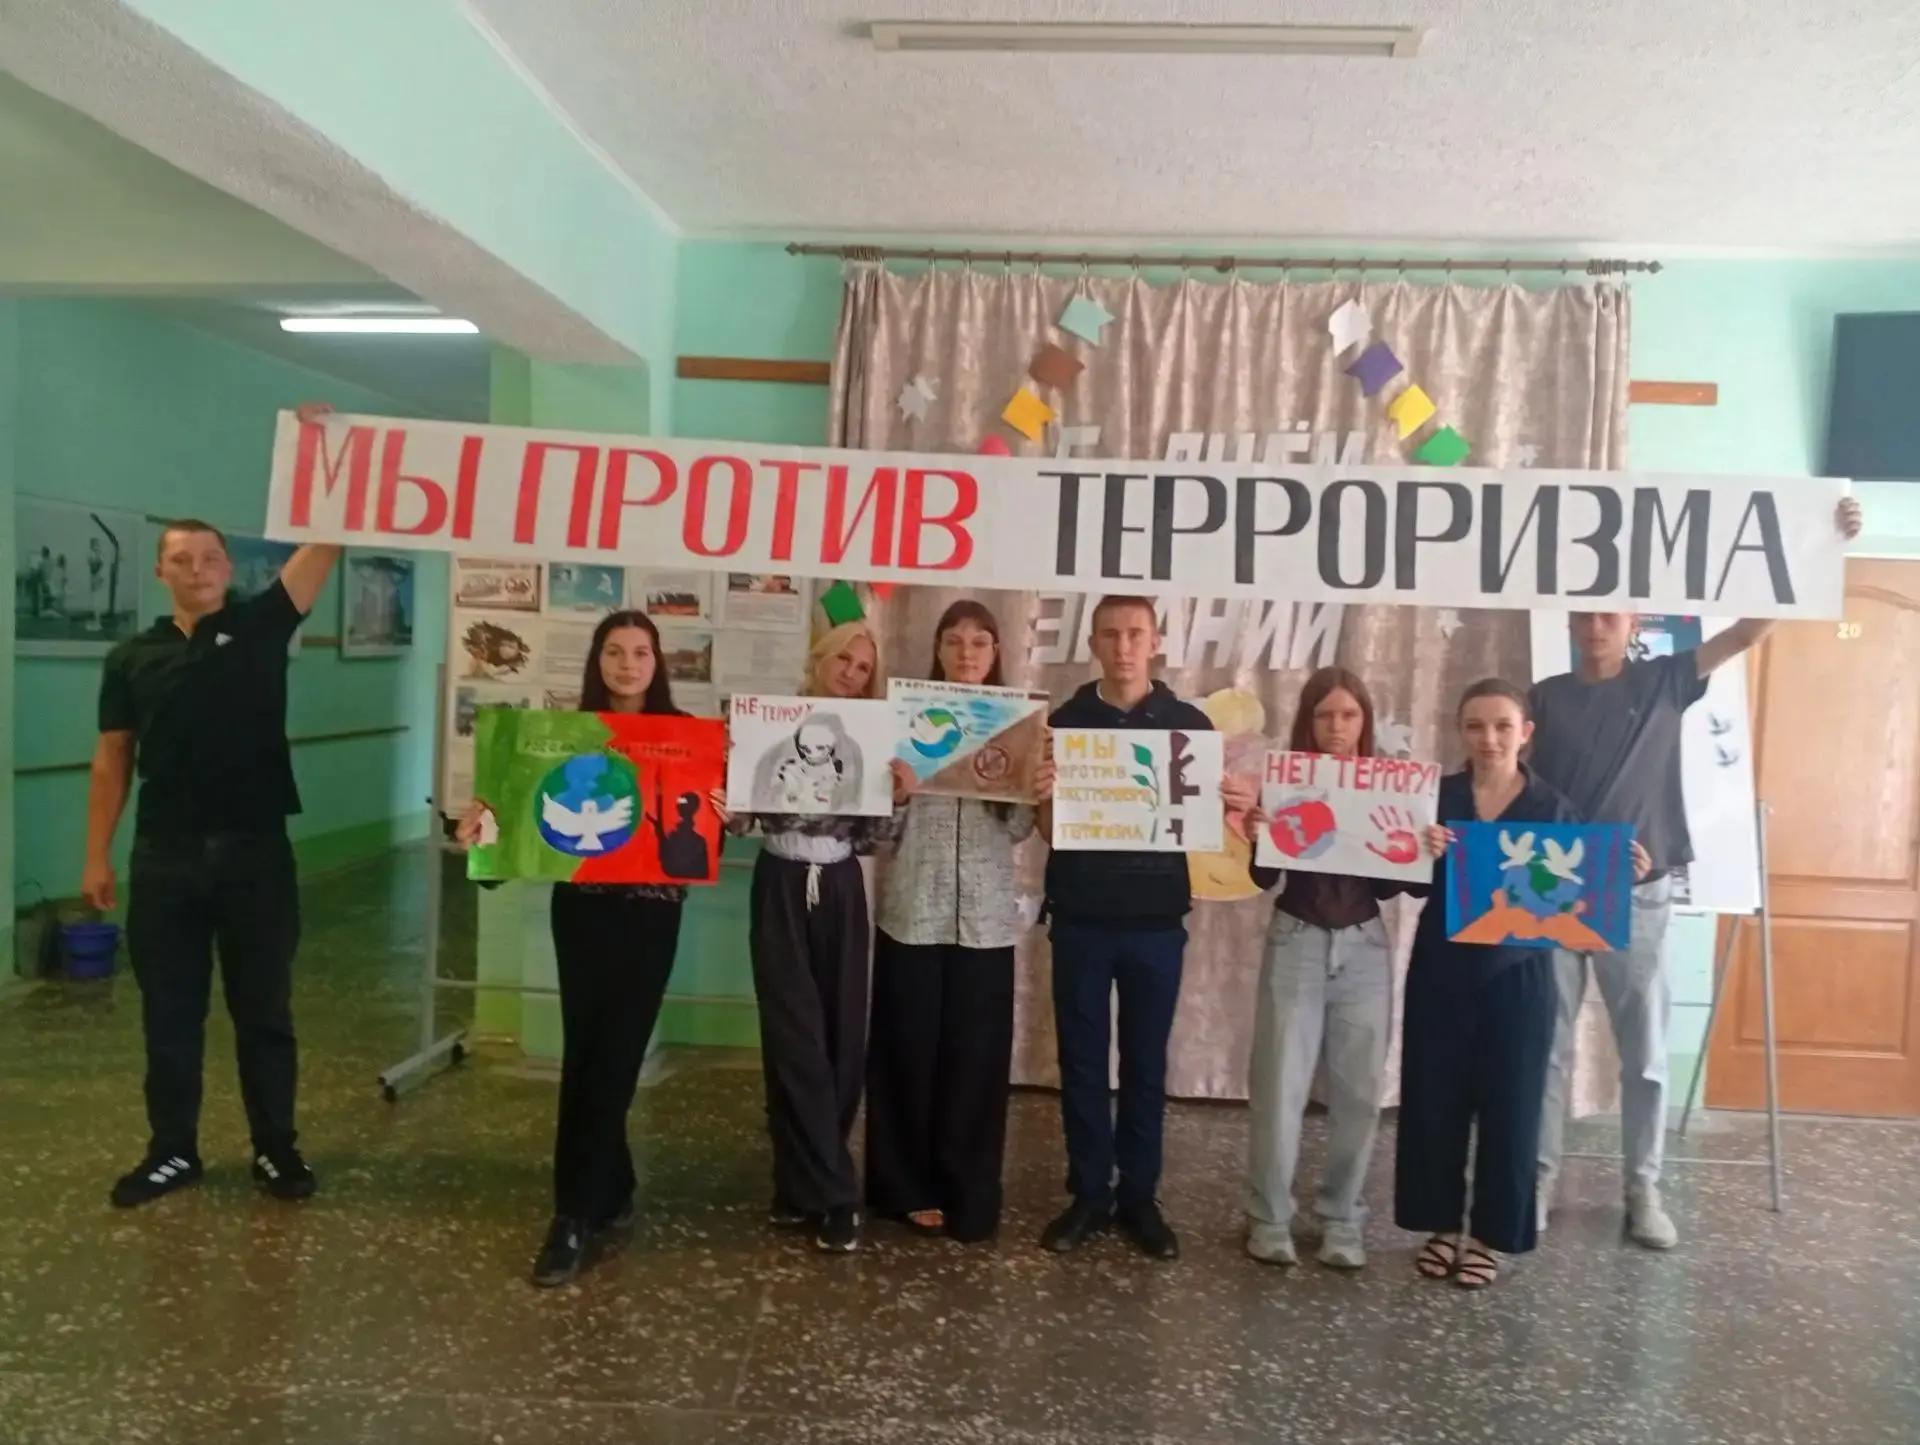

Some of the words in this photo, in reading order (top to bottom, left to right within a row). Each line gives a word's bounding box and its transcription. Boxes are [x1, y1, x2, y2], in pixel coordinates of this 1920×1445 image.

[289, 421, 483, 540] МЫ
[513, 440, 980, 571] ПРОТИВ
[1036, 471, 1796, 606] ТЕРРОРИЗМА
[1837, 622, 1862, 639] 20
[1064, 734, 1116, 759] МЫ
[1266, 752, 1322, 785] НЕТ
[1331, 754, 1439, 797] ТЕРРОРУ!
